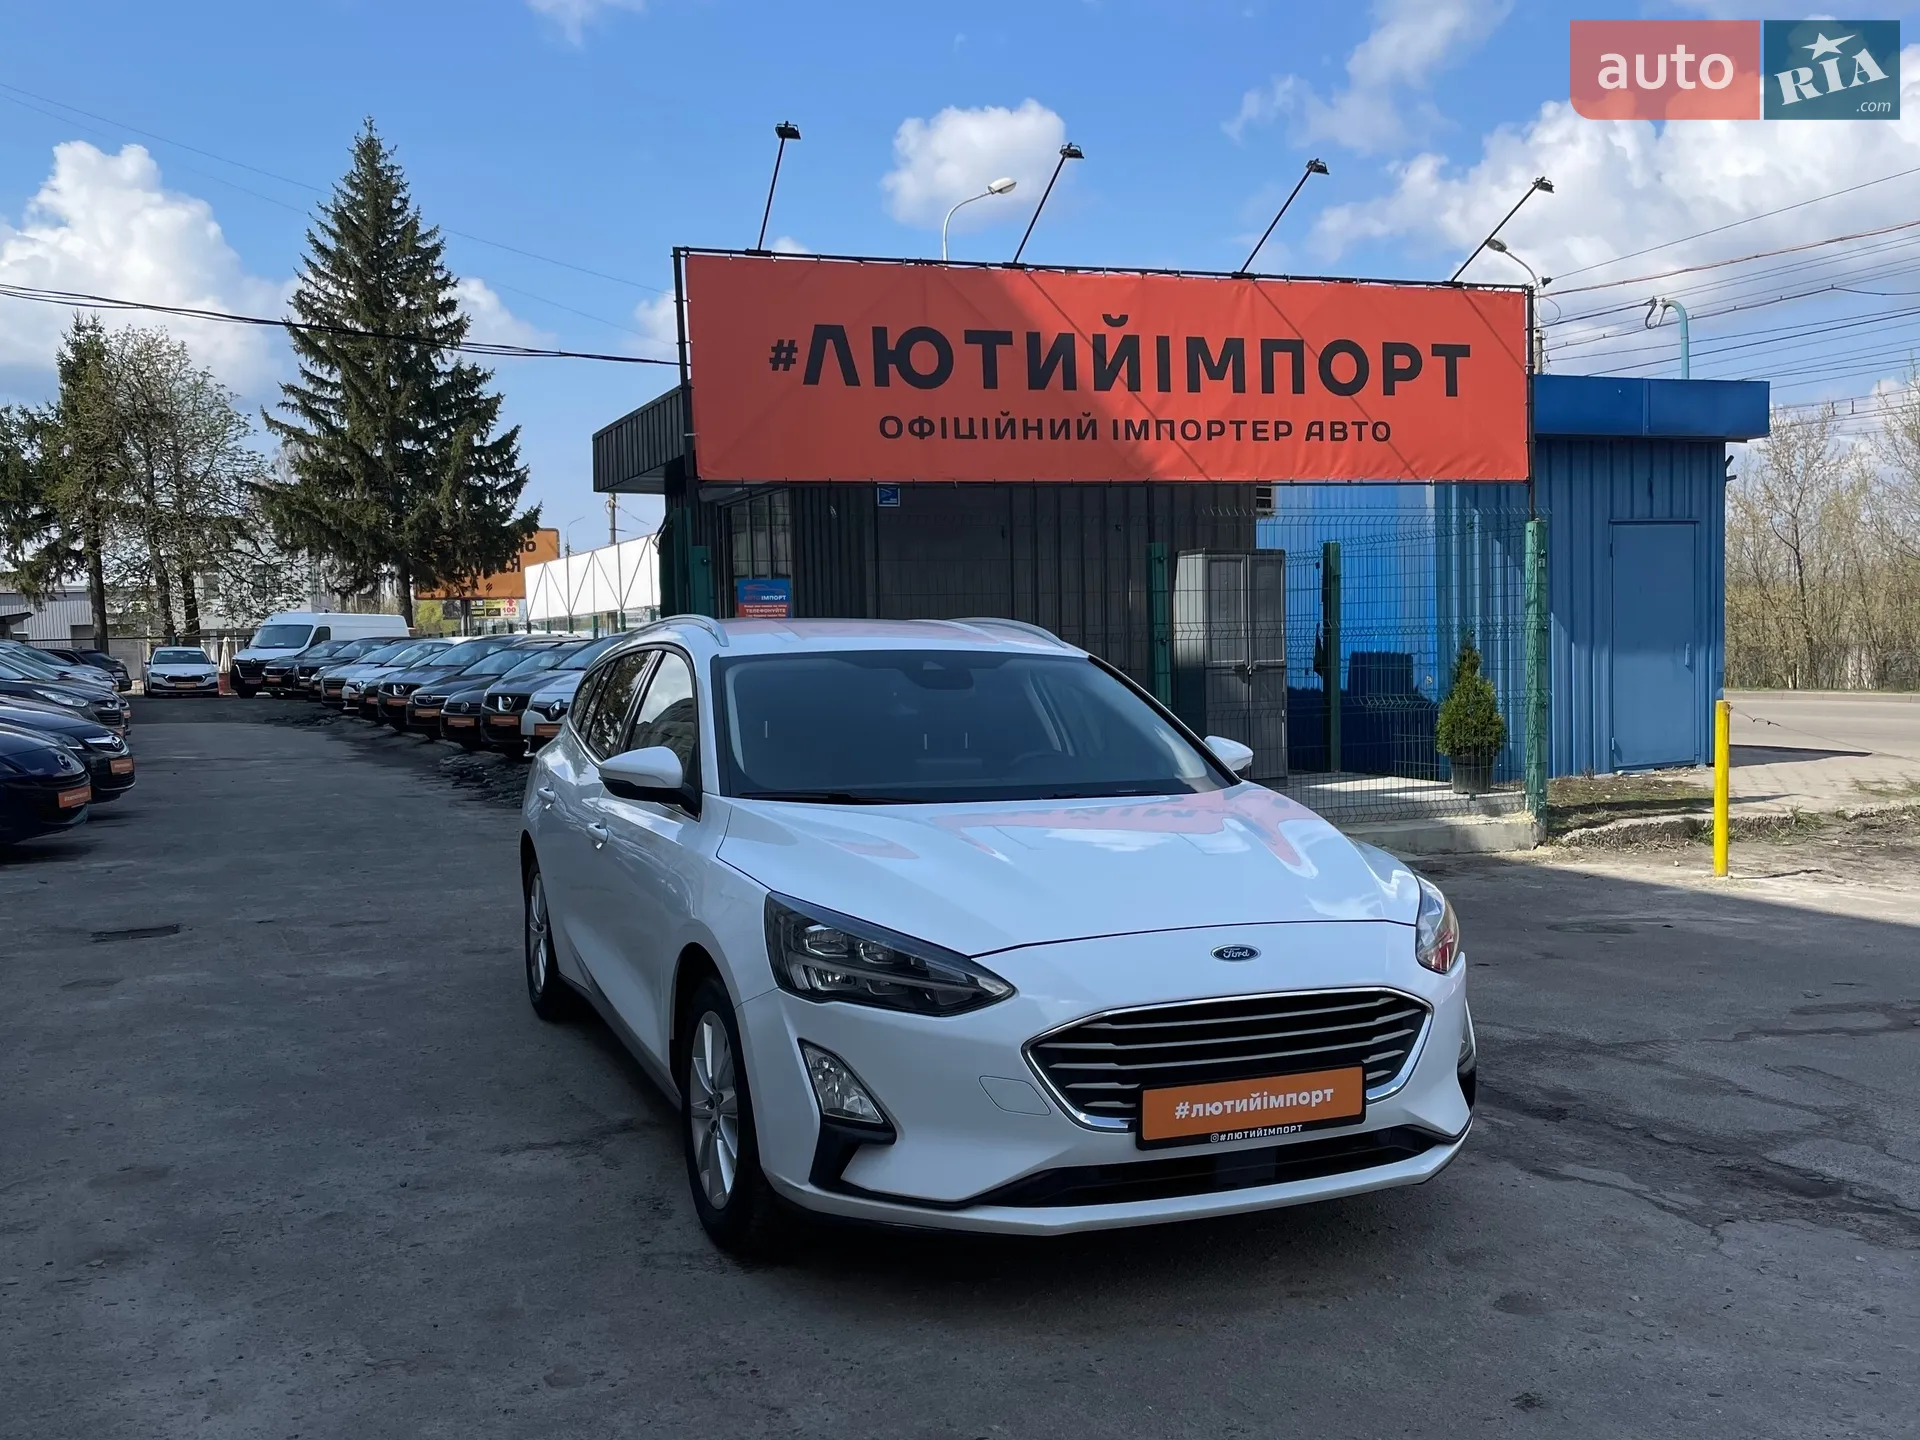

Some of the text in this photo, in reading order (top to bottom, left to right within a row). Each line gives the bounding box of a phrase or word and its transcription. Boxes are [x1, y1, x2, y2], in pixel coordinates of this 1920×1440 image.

[769, 314, 1471, 397] #ЛЮТИЙІМПОРТ
[879, 411, 1391, 442] ОФІЦІЙНИЙ ІМПОРТЕР АВТО
[1223, 947, 1250, 959] Ford
[1174, 1087, 1335, 1120] #лютийімпорт
